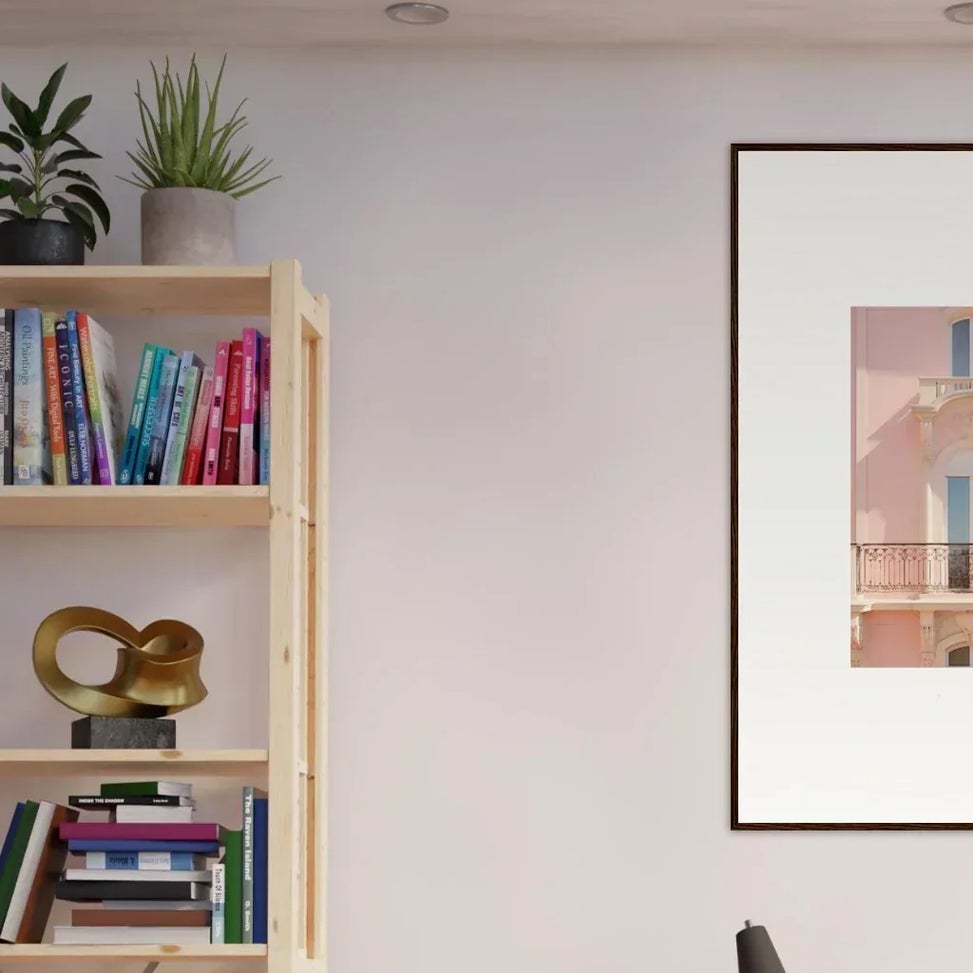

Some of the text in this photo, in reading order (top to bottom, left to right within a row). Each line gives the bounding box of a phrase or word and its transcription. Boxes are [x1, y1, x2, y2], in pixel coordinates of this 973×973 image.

[20, 325, 32, 386] Oil Paintings
[72, 360, 81, 384] Beauty
[80, 327, 98, 410] Watercolor Portraits
[50, 385, 58, 402] With
[59, 345, 74, 408] ICONIC
[230, 364, 240, 416] Parenting Skills
[49, 402, 60, 425] Digital
[52, 425, 62, 442] Tools
[143, 397, 158, 446] SUCCESSFUL
[80, 440, 88, 472] NORMAN
